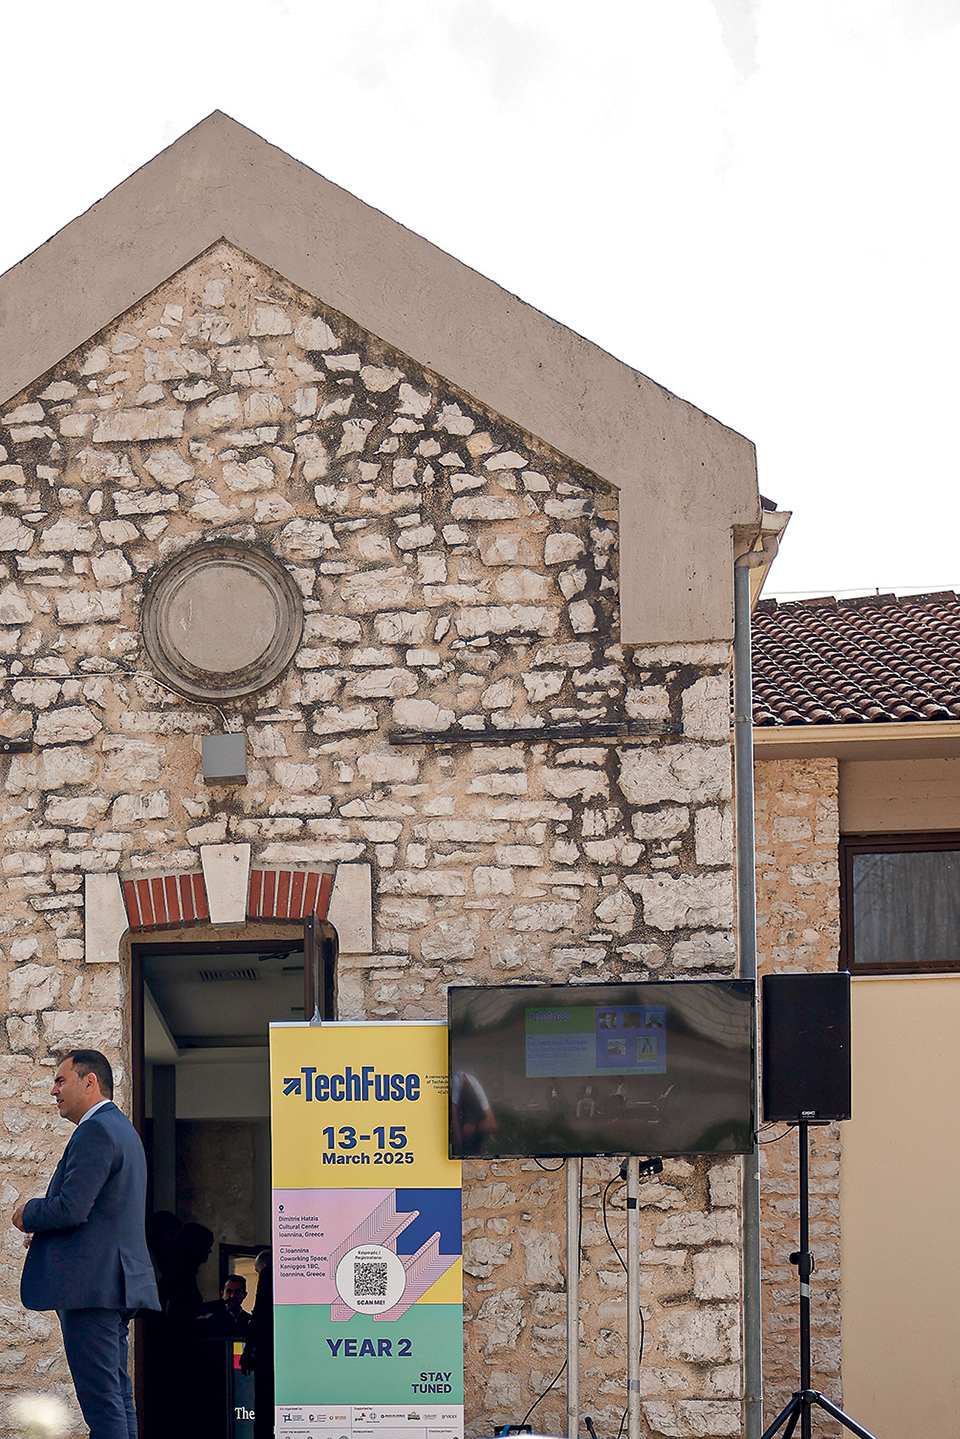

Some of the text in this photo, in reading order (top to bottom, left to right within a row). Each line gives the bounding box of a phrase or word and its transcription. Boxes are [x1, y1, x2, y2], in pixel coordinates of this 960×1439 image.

[533, 1010, 571, 1021] TechFuse
[301, 1067, 420, 1101] TechFuse
[322, 1126, 408, 1149] 13-15
[322, 1152, 415, 1165] March 2025
[326, 1338, 412, 1357] YEAR 2
[420, 1372, 452, 1382] STAY
[411, 1383, 452, 1393] TUNED
[235, 1406, 255, 1420] The
